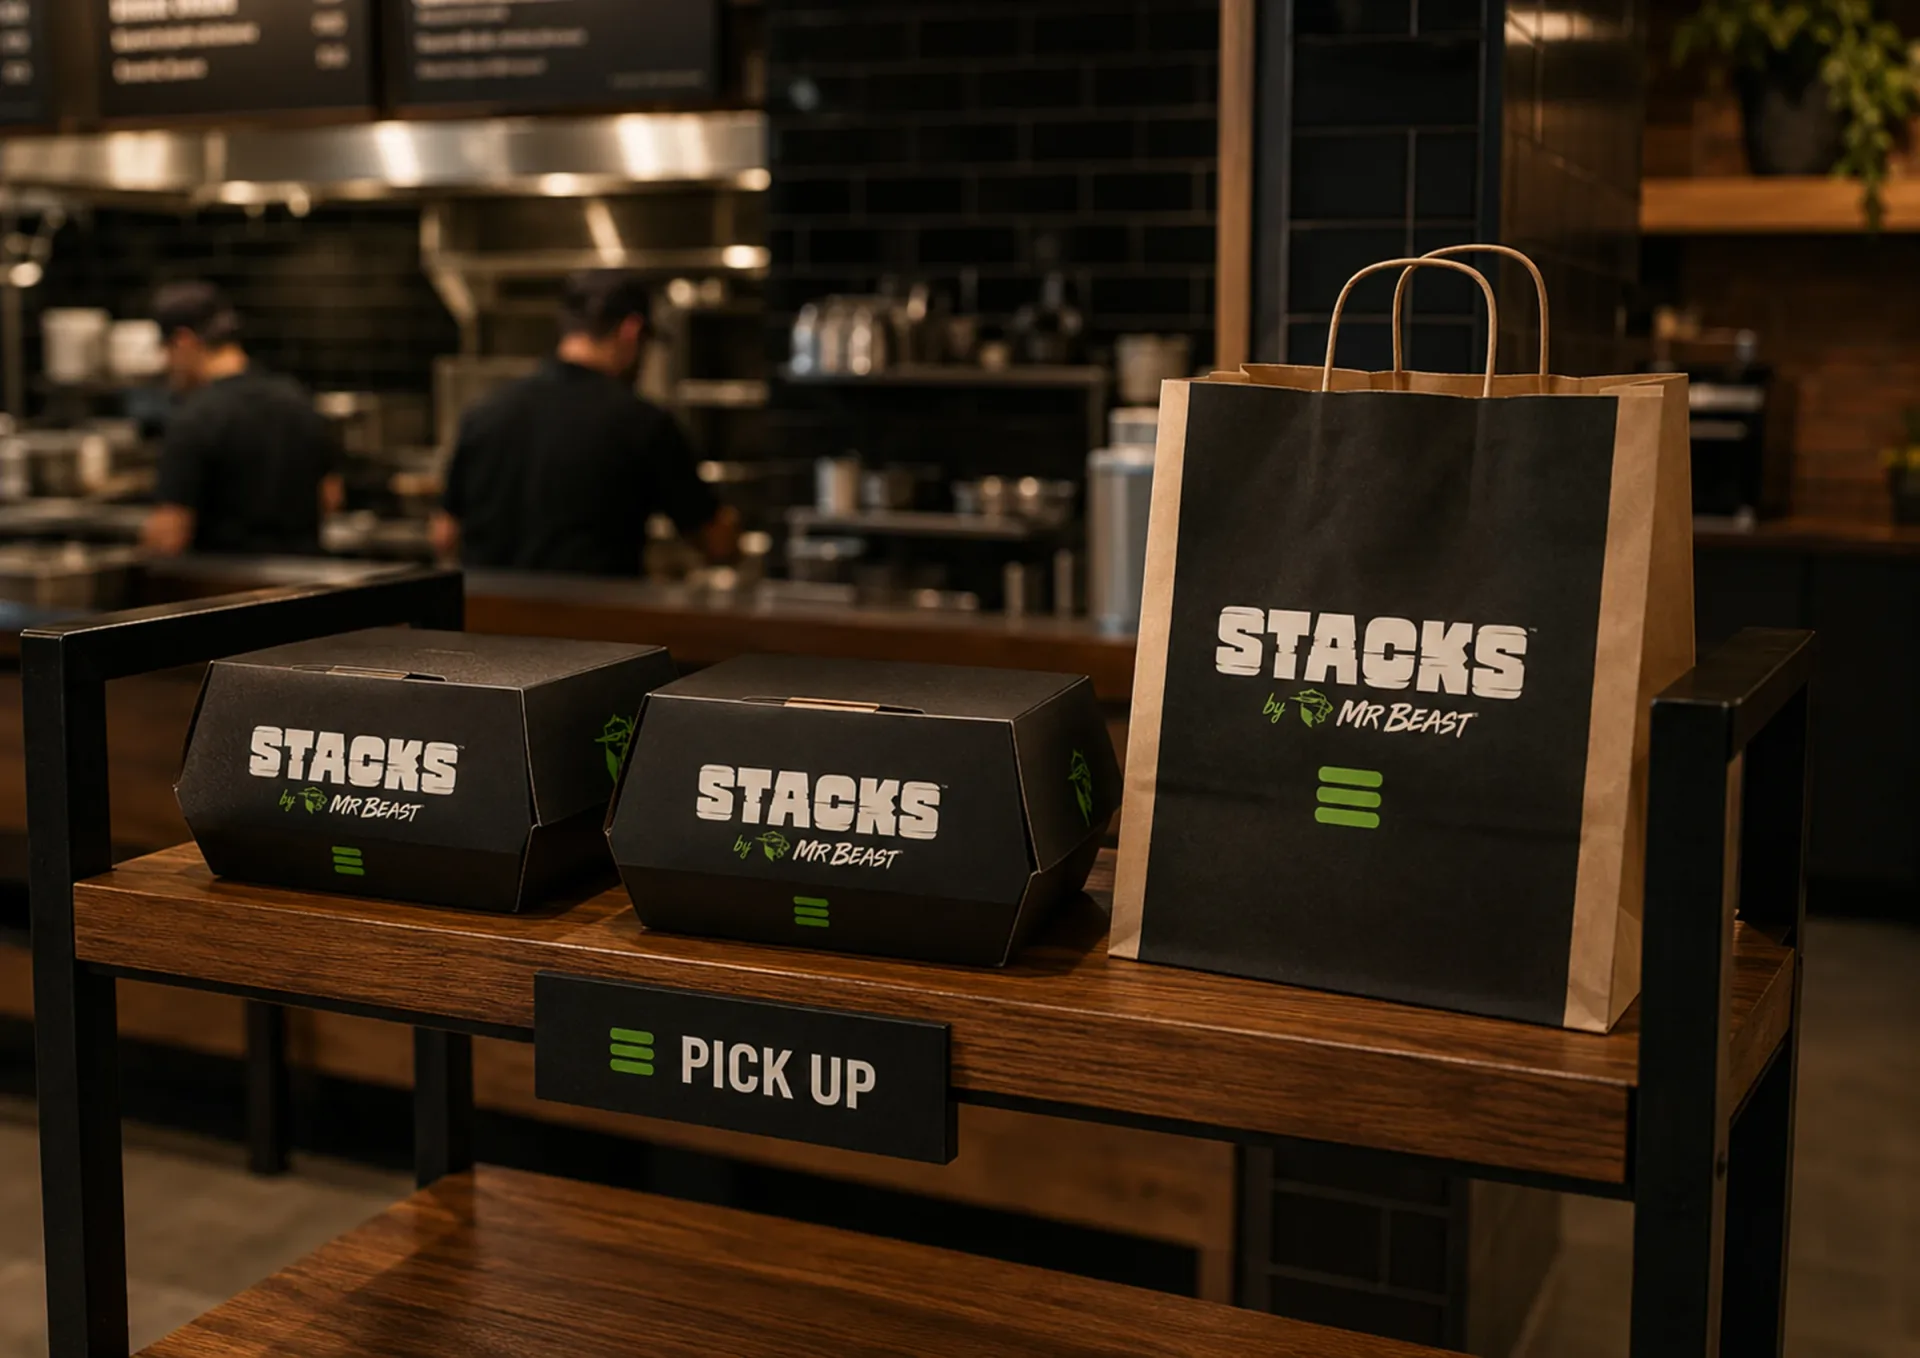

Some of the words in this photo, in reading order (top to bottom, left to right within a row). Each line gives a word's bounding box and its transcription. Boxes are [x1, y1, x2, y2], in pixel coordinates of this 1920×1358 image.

[1215, 605, 1528, 700] STACKS
[1262, 693, 1286, 724] by
[248, 725, 459, 796] STACKS
[278, 789, 295, 812] by
[695, 763, 941, 840] STACKS
[733, 835, 752, 859] by
[681, 1035, 794, 1100] PICK
[810, 1053, 876, 1110] UP
